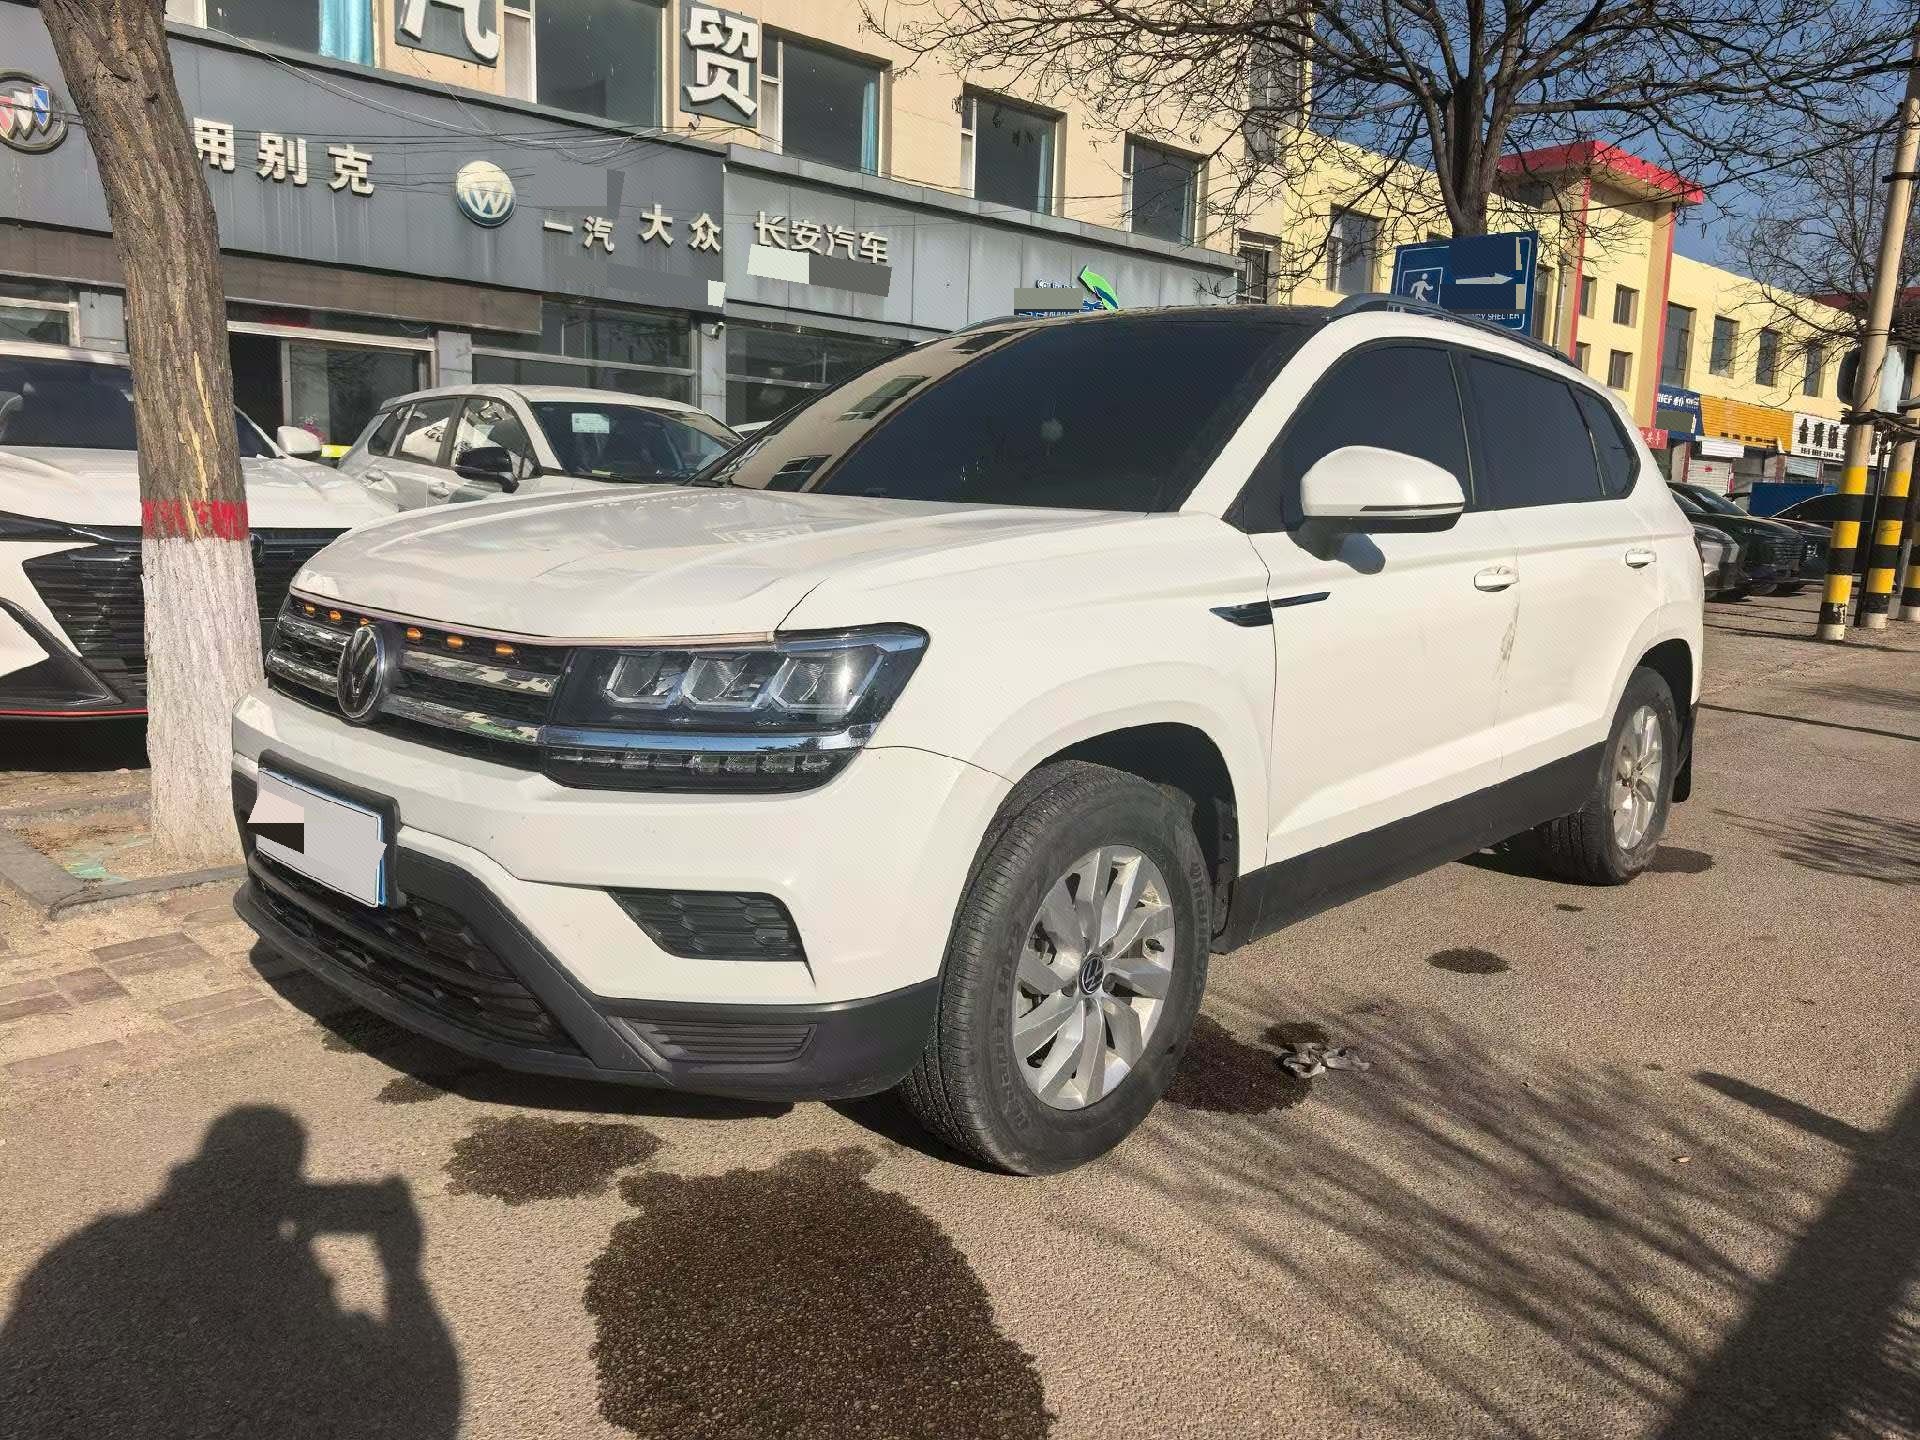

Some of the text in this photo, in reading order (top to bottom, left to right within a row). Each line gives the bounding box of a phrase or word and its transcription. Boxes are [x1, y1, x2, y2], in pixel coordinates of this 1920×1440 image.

[686, 7, 757, 118] 贸
[193, 117, 375, 197] 用别克
[458, 162, 515, 223] W
[544, 204, 722, 255] 一汽大众
[754, 211, 889, 264] 长安汽车
